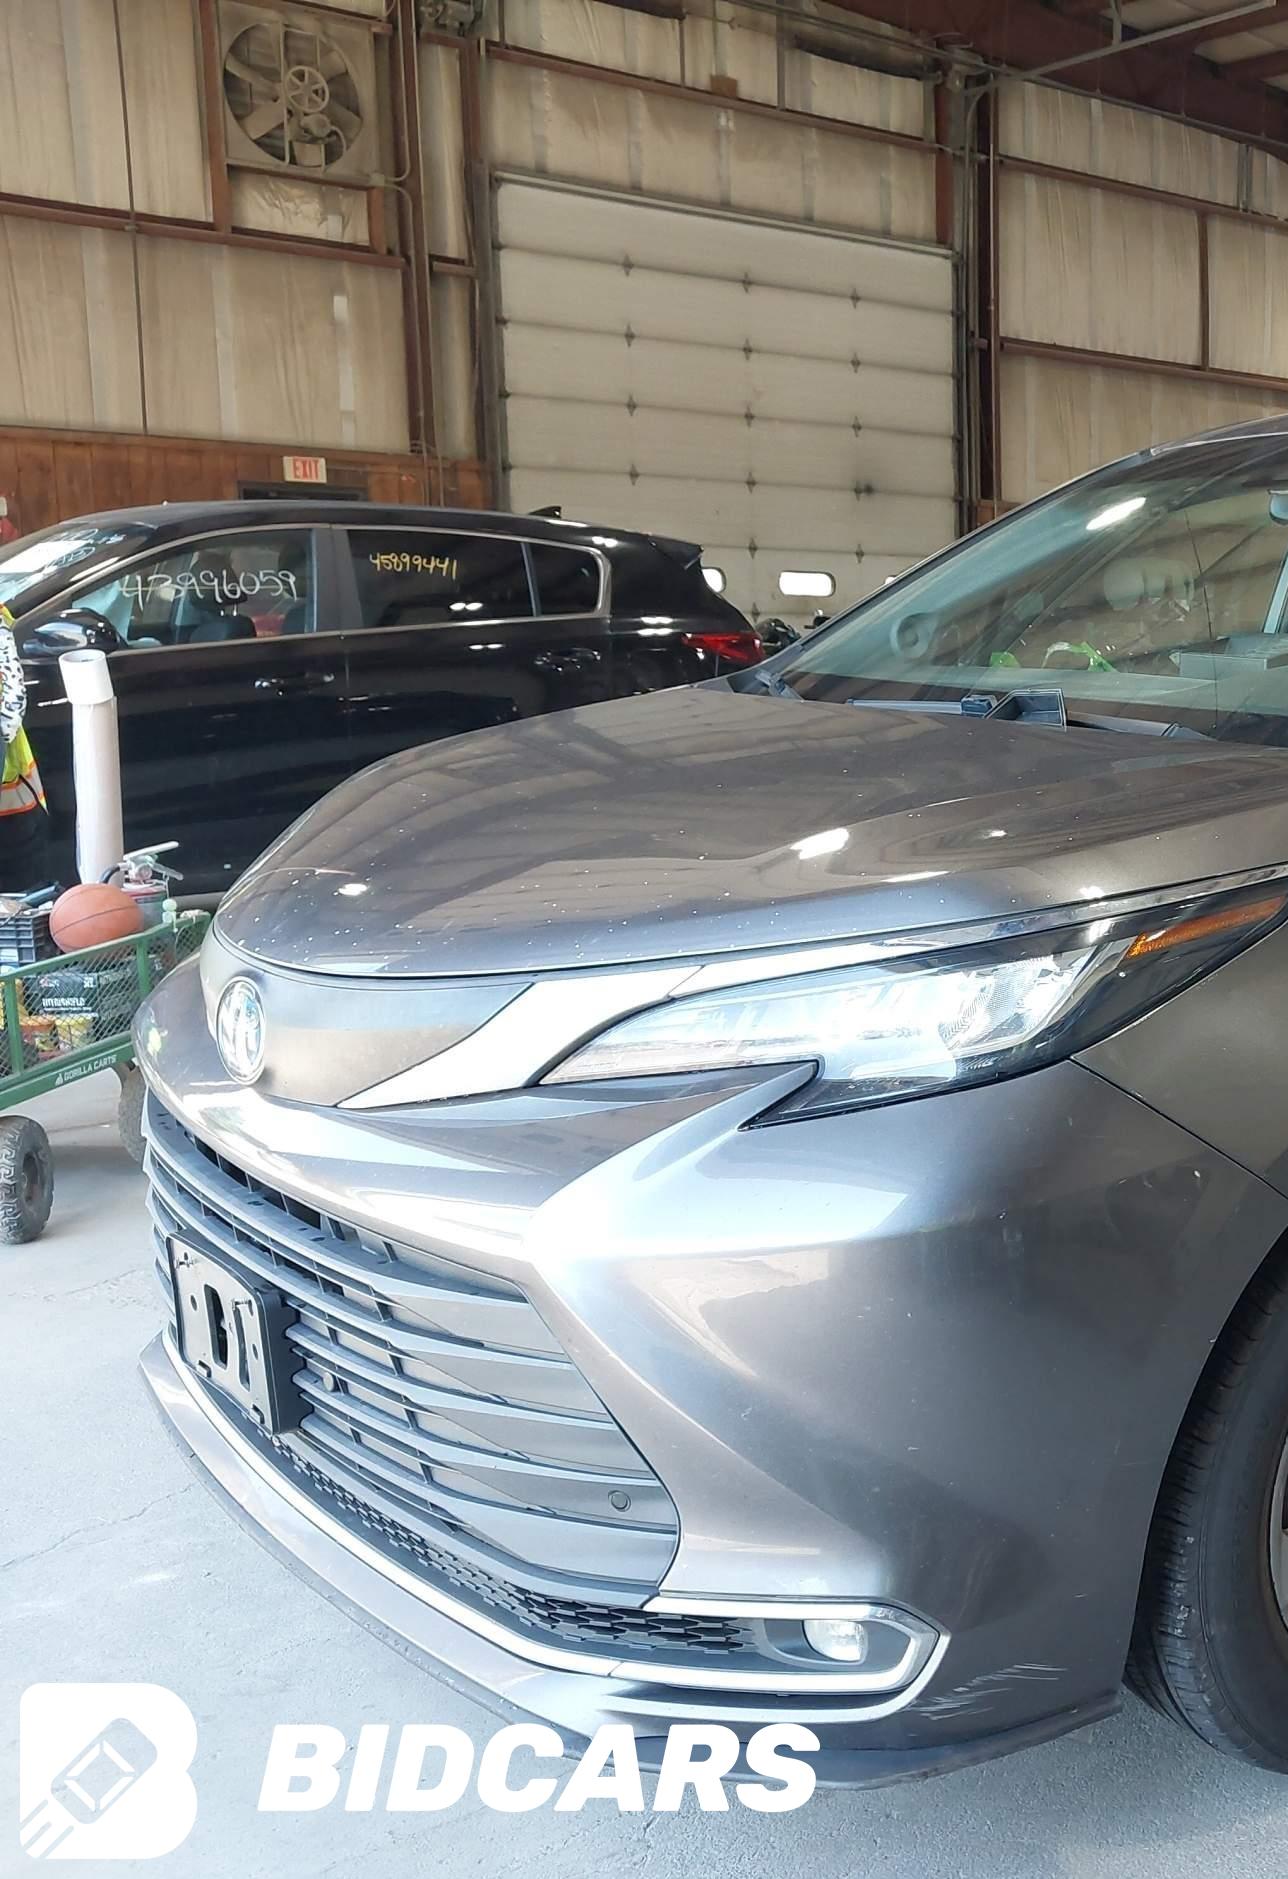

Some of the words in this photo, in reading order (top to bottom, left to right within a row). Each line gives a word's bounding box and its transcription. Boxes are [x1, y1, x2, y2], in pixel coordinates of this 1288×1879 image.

[293, 457, 320, 481] EXIT
[369, 552, 457, 580] 45899441
[64, 1063, 93, 1081] GORILLA
[93, 1054, 117, 1070] CARTS
